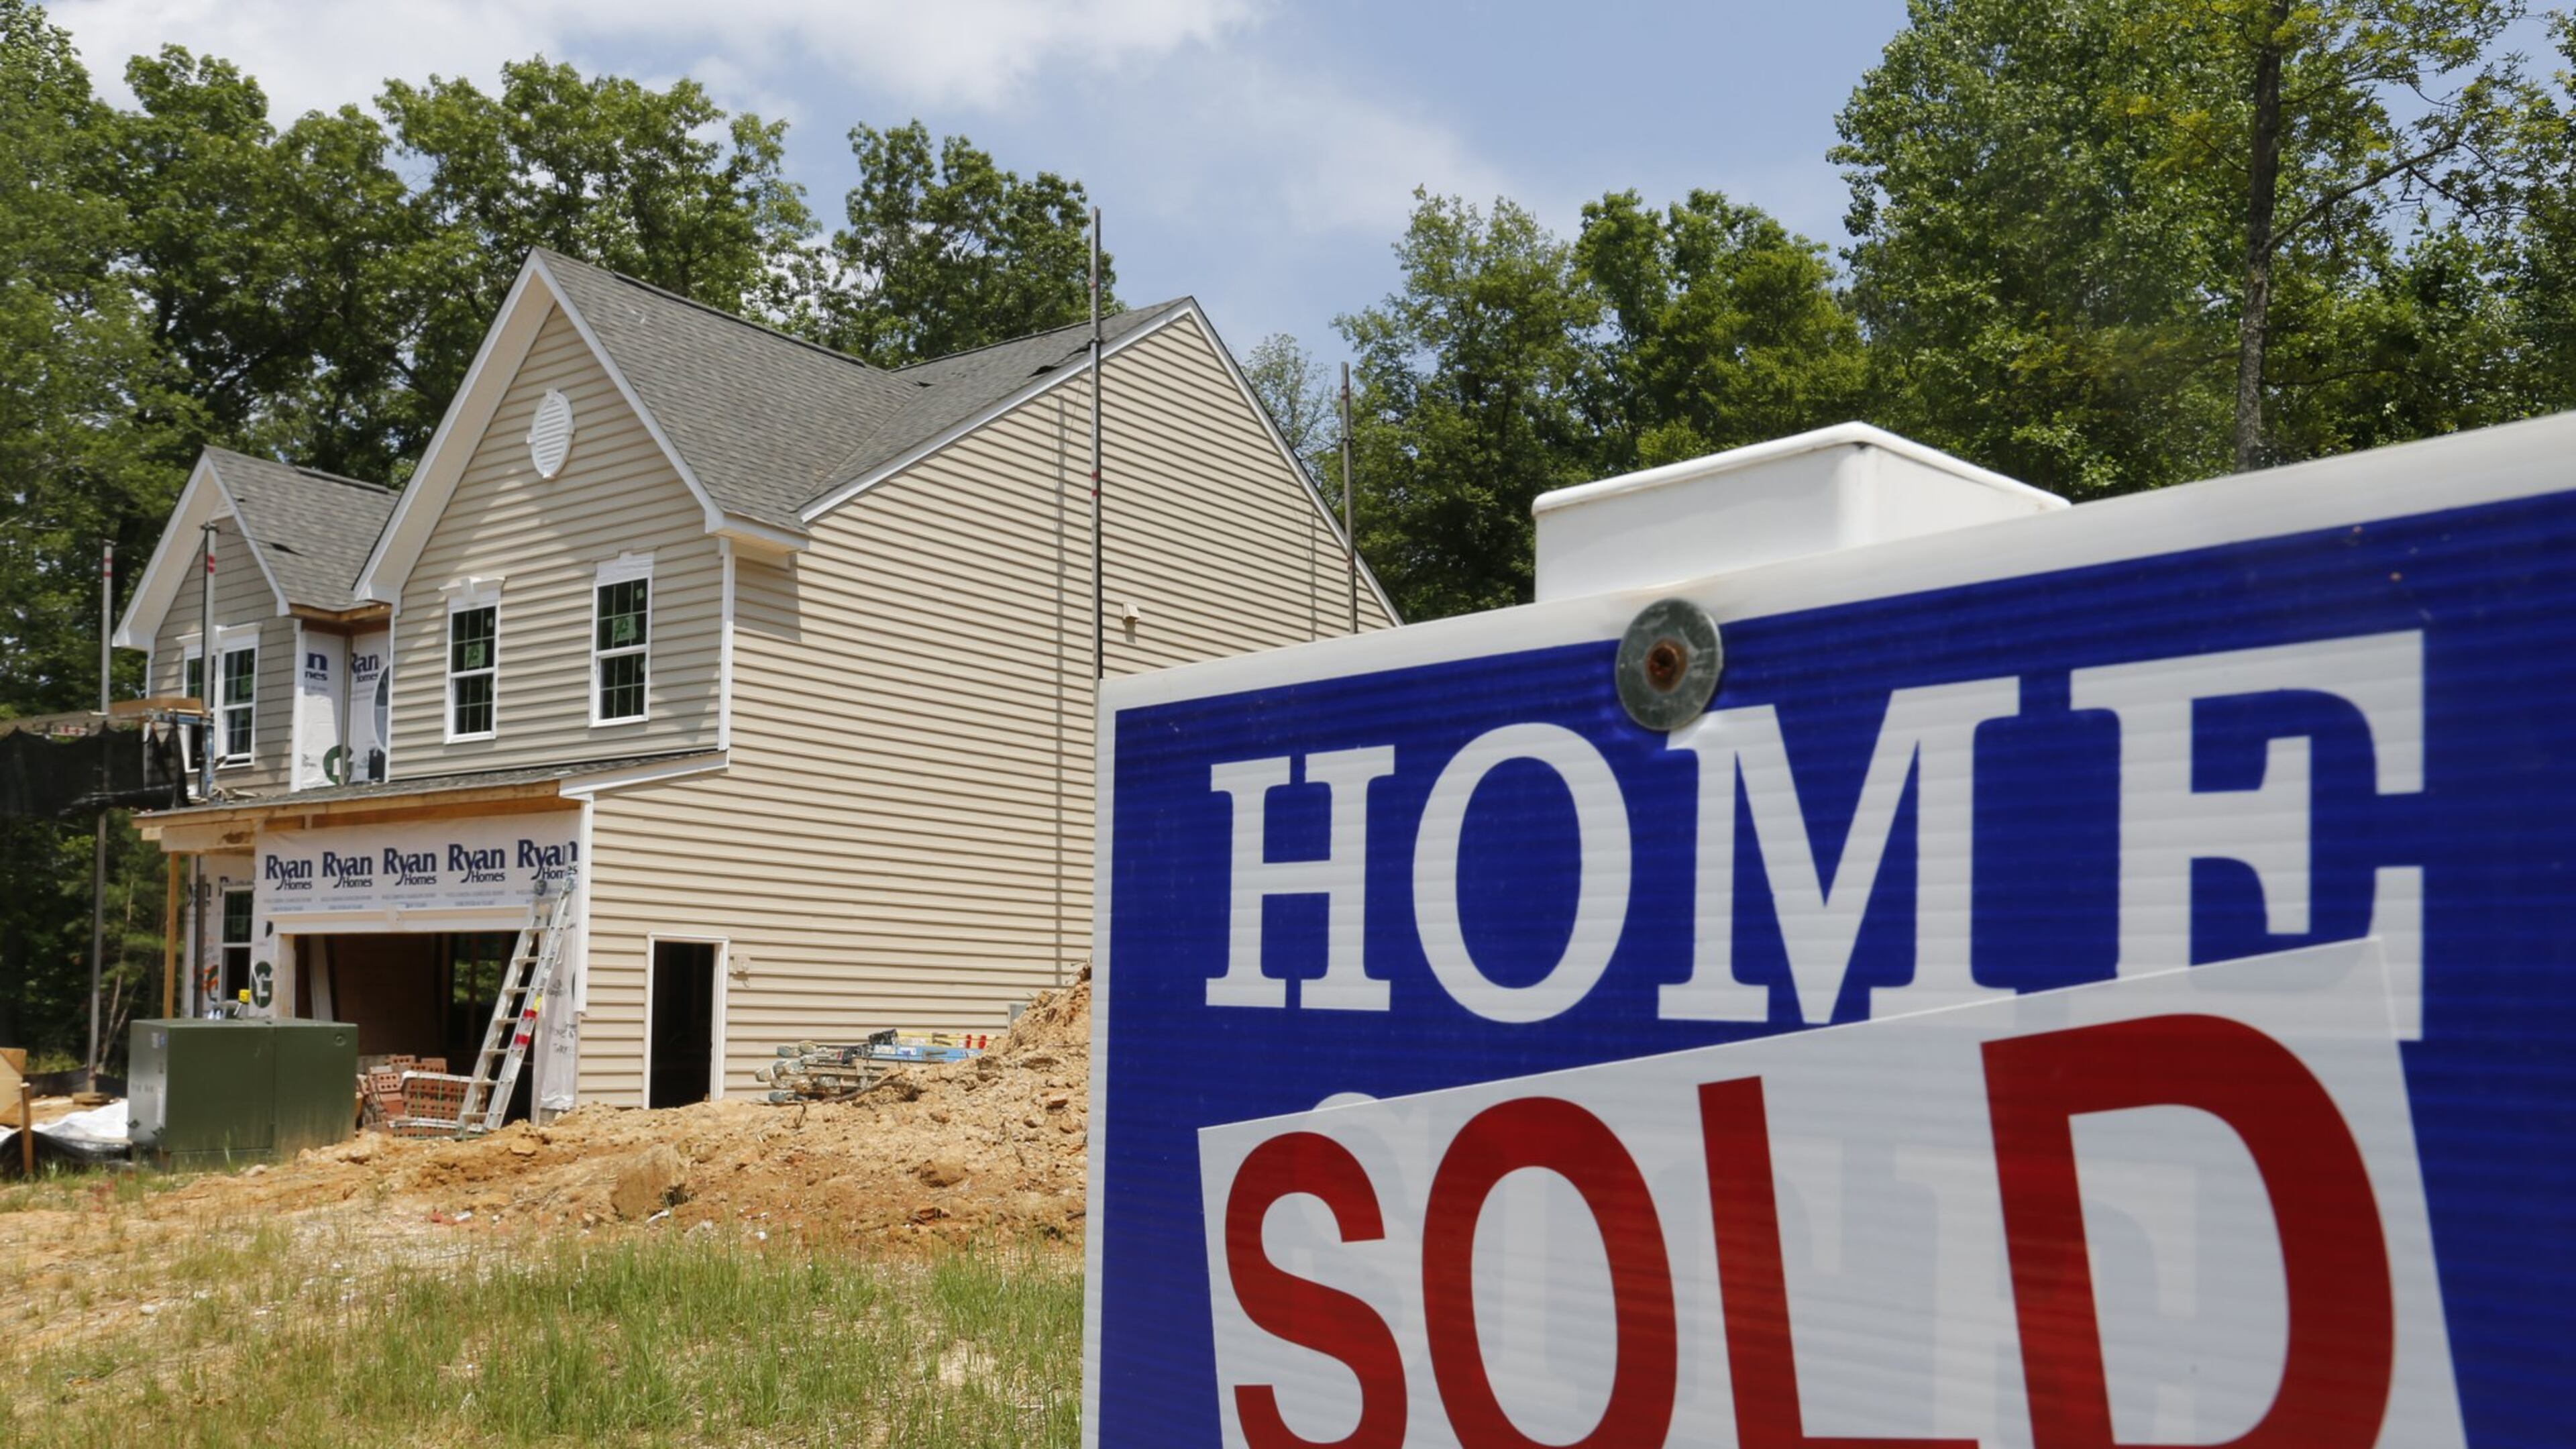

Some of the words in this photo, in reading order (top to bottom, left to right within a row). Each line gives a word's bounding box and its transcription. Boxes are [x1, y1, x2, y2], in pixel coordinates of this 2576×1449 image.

[265, 855, 312, 890] Ryan
[322, 851, 373, 888] Ryan
[383, 848, 437, 885] Ryan
[447, 843, 505, 883] Ryan
[517, 839, 578, 880] Ryan
[284, 878, 312, 890] Homes
[343, 876, 373, 888] Homes
[404, 873, 437, 885] Homes
[471, 869, 505, 883] Homes
[1204, 629, 2424, 1042] HOME
[1224, 1014, 2396, 1449] SOLD
